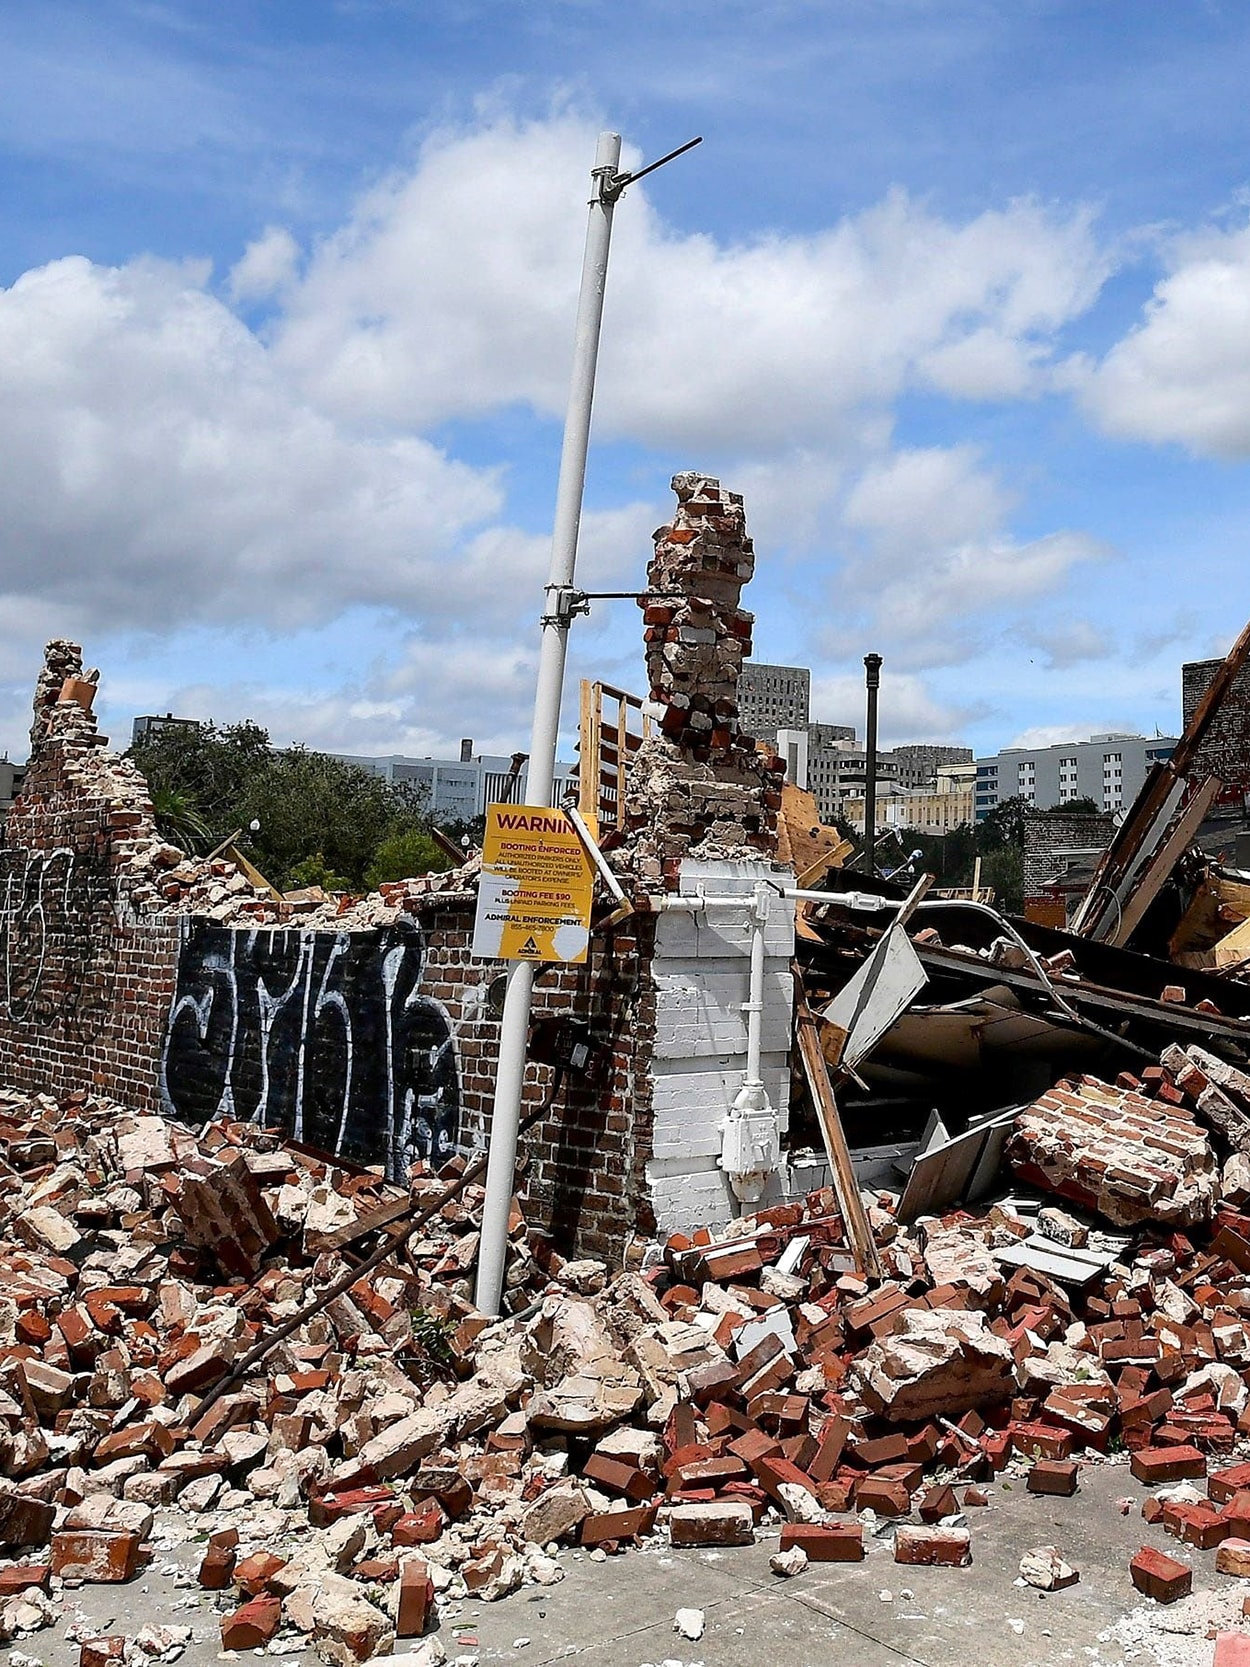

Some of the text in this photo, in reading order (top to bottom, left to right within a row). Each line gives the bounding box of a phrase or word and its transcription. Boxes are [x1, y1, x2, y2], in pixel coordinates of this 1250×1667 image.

[496, 813, 589, 836] WARNIN
[501, 842, 581, 855] BOOTING ENFORCED
[498, 852, 537, 861] AUTHORIZED
[537, 855, 564, 863] PARKERS
[509, 859, 554, 869] UNAUTHORIZED
[555, 863, 583, 871] VEHICLES
[518, 867, 543, 875] BOOTED
[501, 889, 571, 901] BOOTING FEE $90
[510, 898, 533, 906] UNPAID
[533, 900, 560, 908] PARKING
[560, 901, 576, 909] FEES
[484, 913, 582, 926] ADMIRAL ENFORCEMENT
